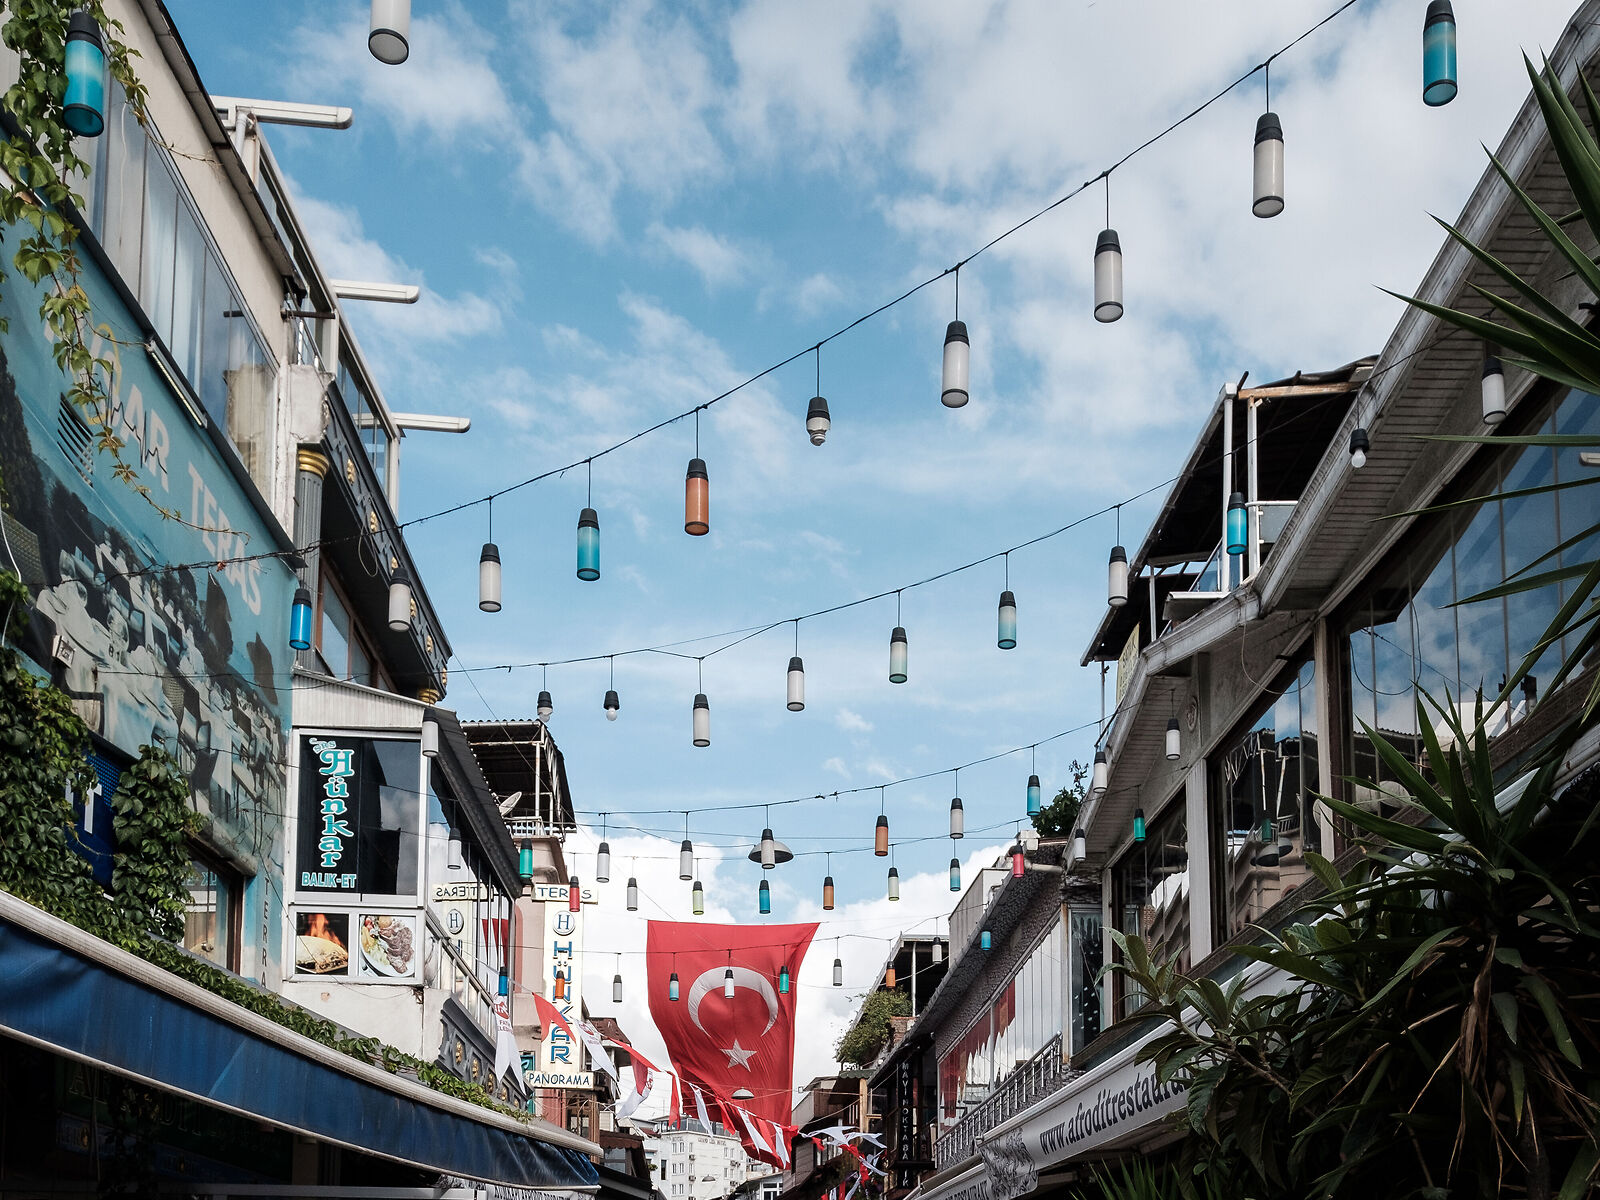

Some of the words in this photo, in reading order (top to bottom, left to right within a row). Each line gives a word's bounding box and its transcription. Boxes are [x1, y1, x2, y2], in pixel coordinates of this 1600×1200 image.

[188, 460, 262, 616] TERAS
[319, 750, 355, 867] Hünkar
[301, 872, 357, 888] BALIK-ET
[538, 887, 592, 899] TERS
[529, 1073, 590, 1087] PANORAMA
[902, 1147, 910, 1187] BAIK
